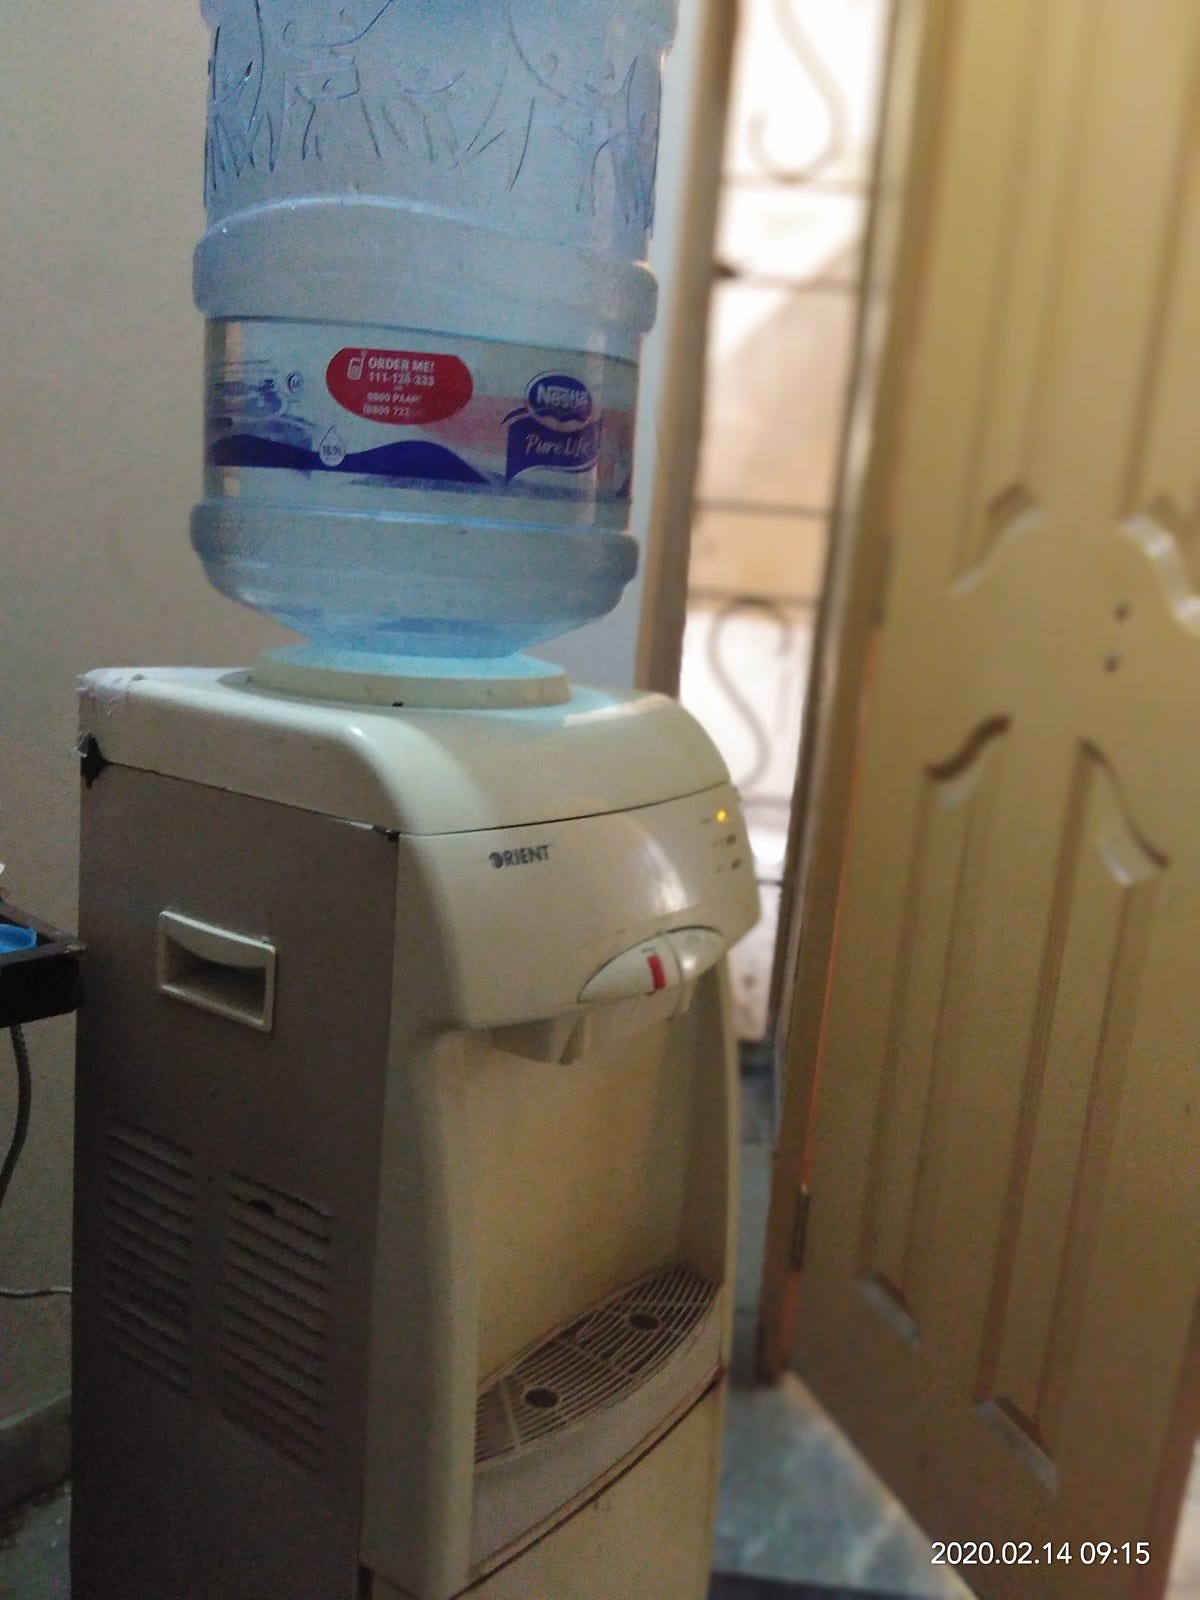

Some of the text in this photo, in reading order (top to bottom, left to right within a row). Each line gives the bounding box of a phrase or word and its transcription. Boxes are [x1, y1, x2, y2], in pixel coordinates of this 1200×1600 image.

[368, 356, 436, 373] ORDER ME!
[524, 433, 562, 455] Pure
[488, 845, 550, 869] ORIENT
